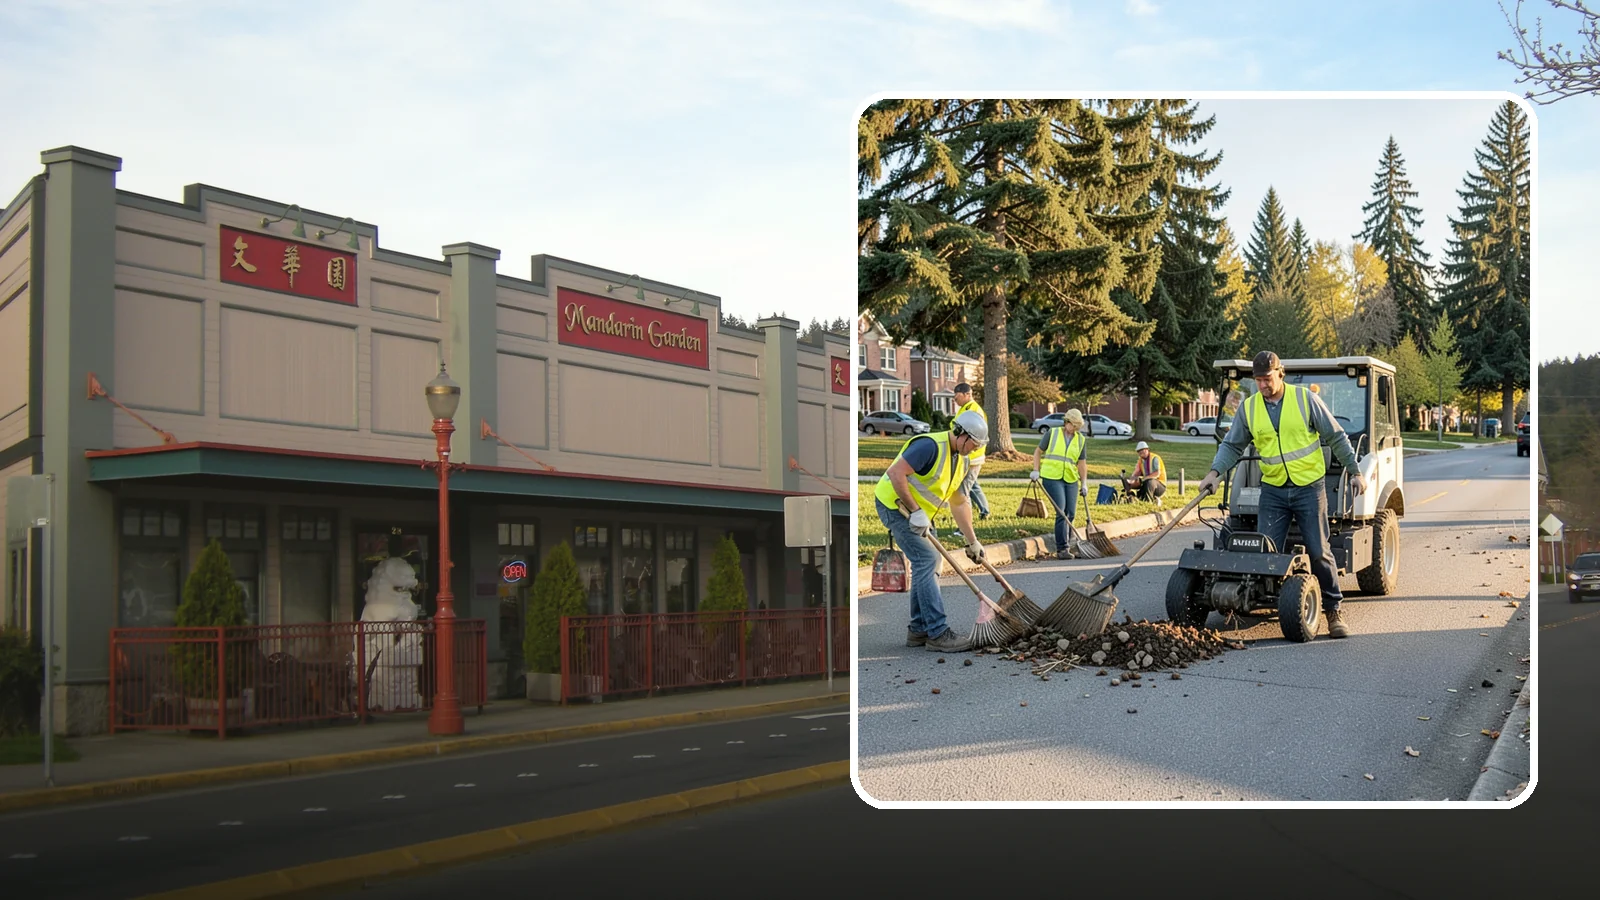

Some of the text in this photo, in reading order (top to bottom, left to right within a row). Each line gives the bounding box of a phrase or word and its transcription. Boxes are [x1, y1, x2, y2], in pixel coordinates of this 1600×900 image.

[230, 235, 346, 291] 文華園
[564, 302, 702, 352] Mandarin Garden
[503, 565, 527, 578] OPEN
